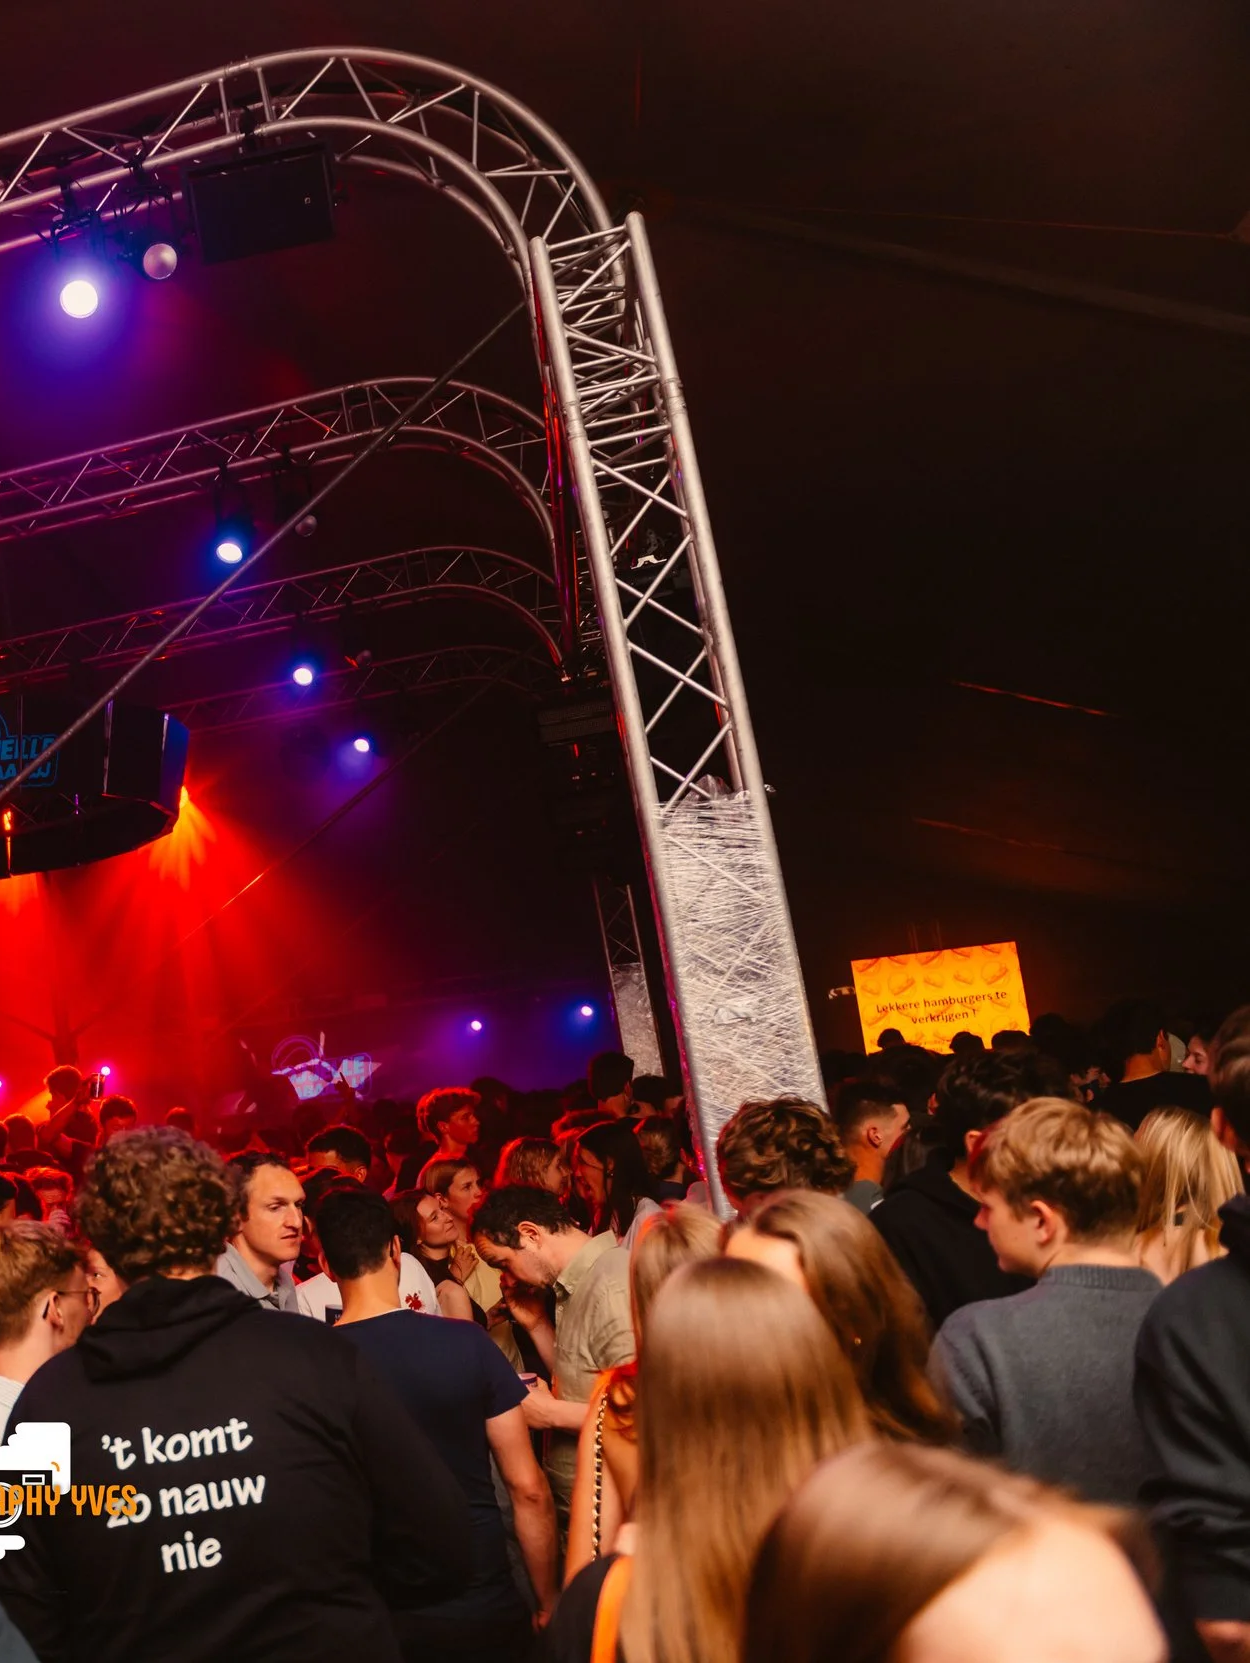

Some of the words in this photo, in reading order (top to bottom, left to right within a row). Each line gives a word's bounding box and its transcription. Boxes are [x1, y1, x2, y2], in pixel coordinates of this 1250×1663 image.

[876, 1001, 920, 1014] Lekkere
[923, 992, 993, 1008] hamburgers
[995, 990, 1007, 1001] te
[911, 1010, 969, 1025] verkrijgen
[101, 1434, 137, 1470] 't
[141, 1417, 254, 1464] komt
[104, 1492, 152, 1529] zo
[159, 1474, 266, 1517] nauw
[161, 1530, 222, 1573] nie
